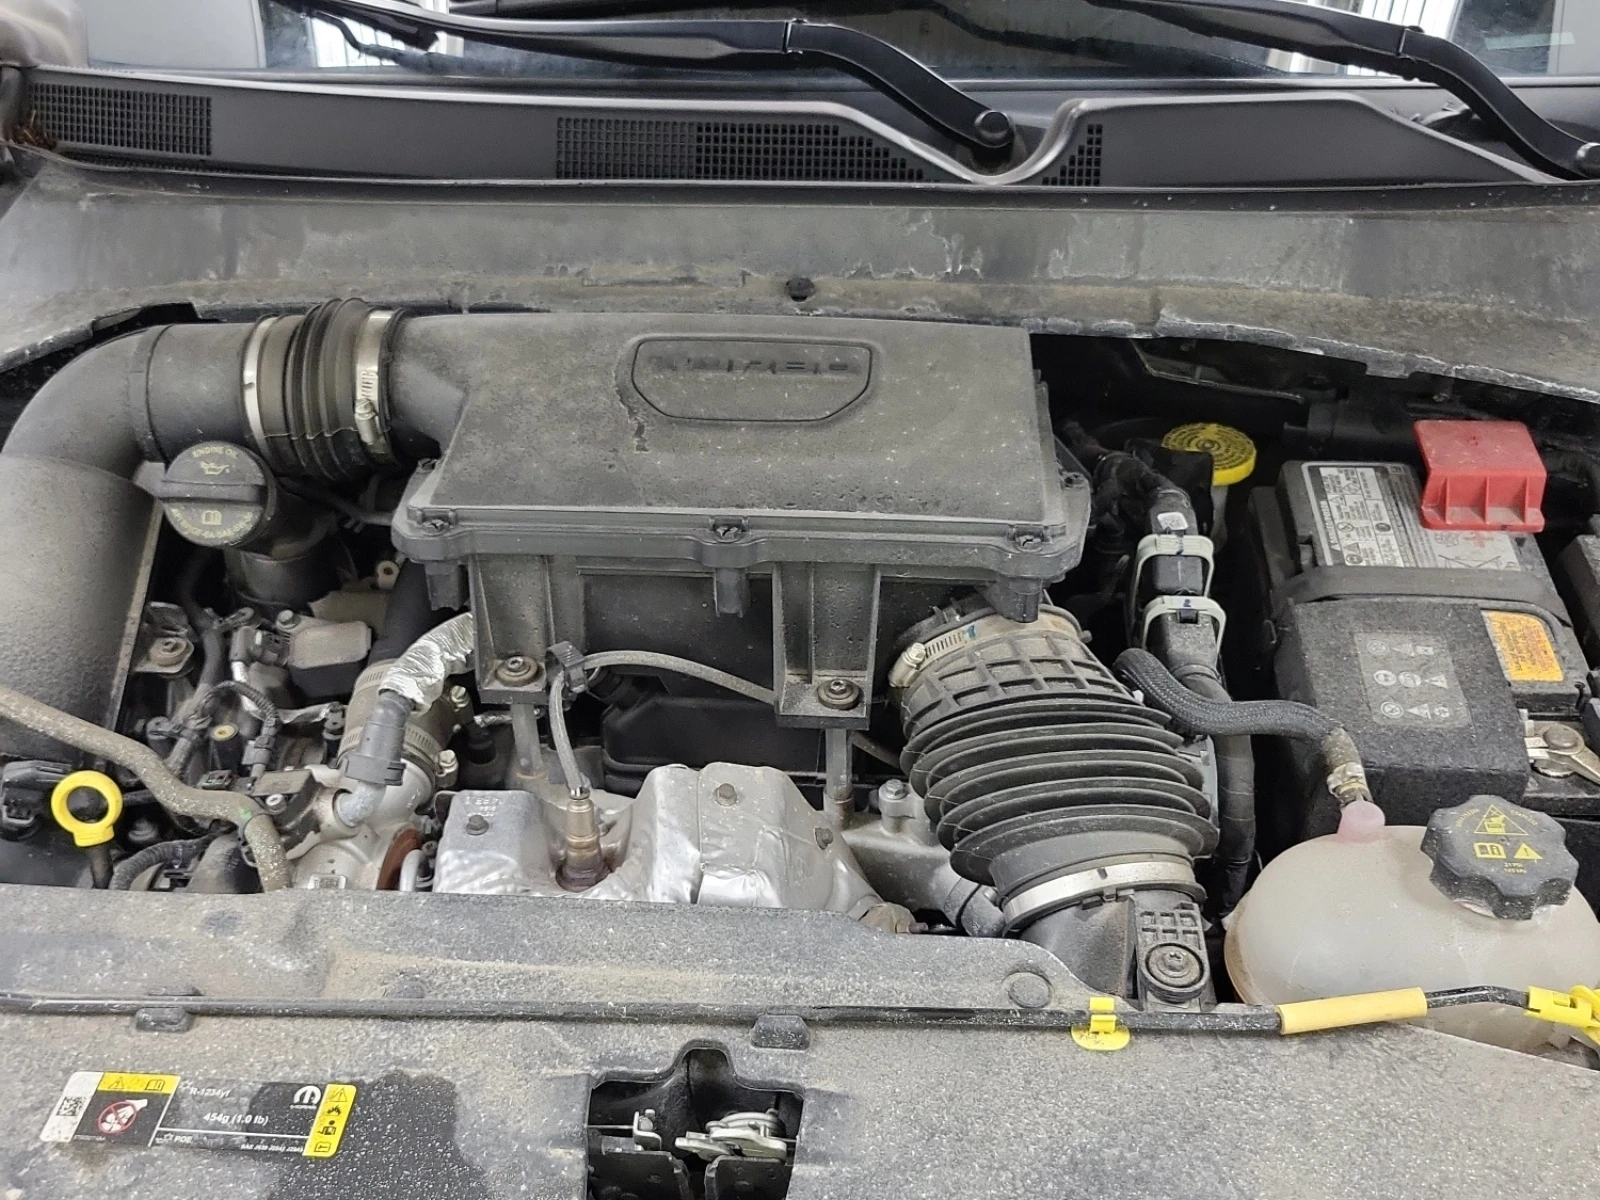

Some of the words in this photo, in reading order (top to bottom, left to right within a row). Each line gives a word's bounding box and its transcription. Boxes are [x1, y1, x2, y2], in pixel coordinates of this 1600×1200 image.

[192, 446, 225, 458] ENGINE
[189, 1086, 232, 1099] R-1234yf
[203, 1111, 230, 1125] 454g
[230, 1113, 253, 1125] (1.0
[253, 1114, 270, 1127] lb)
